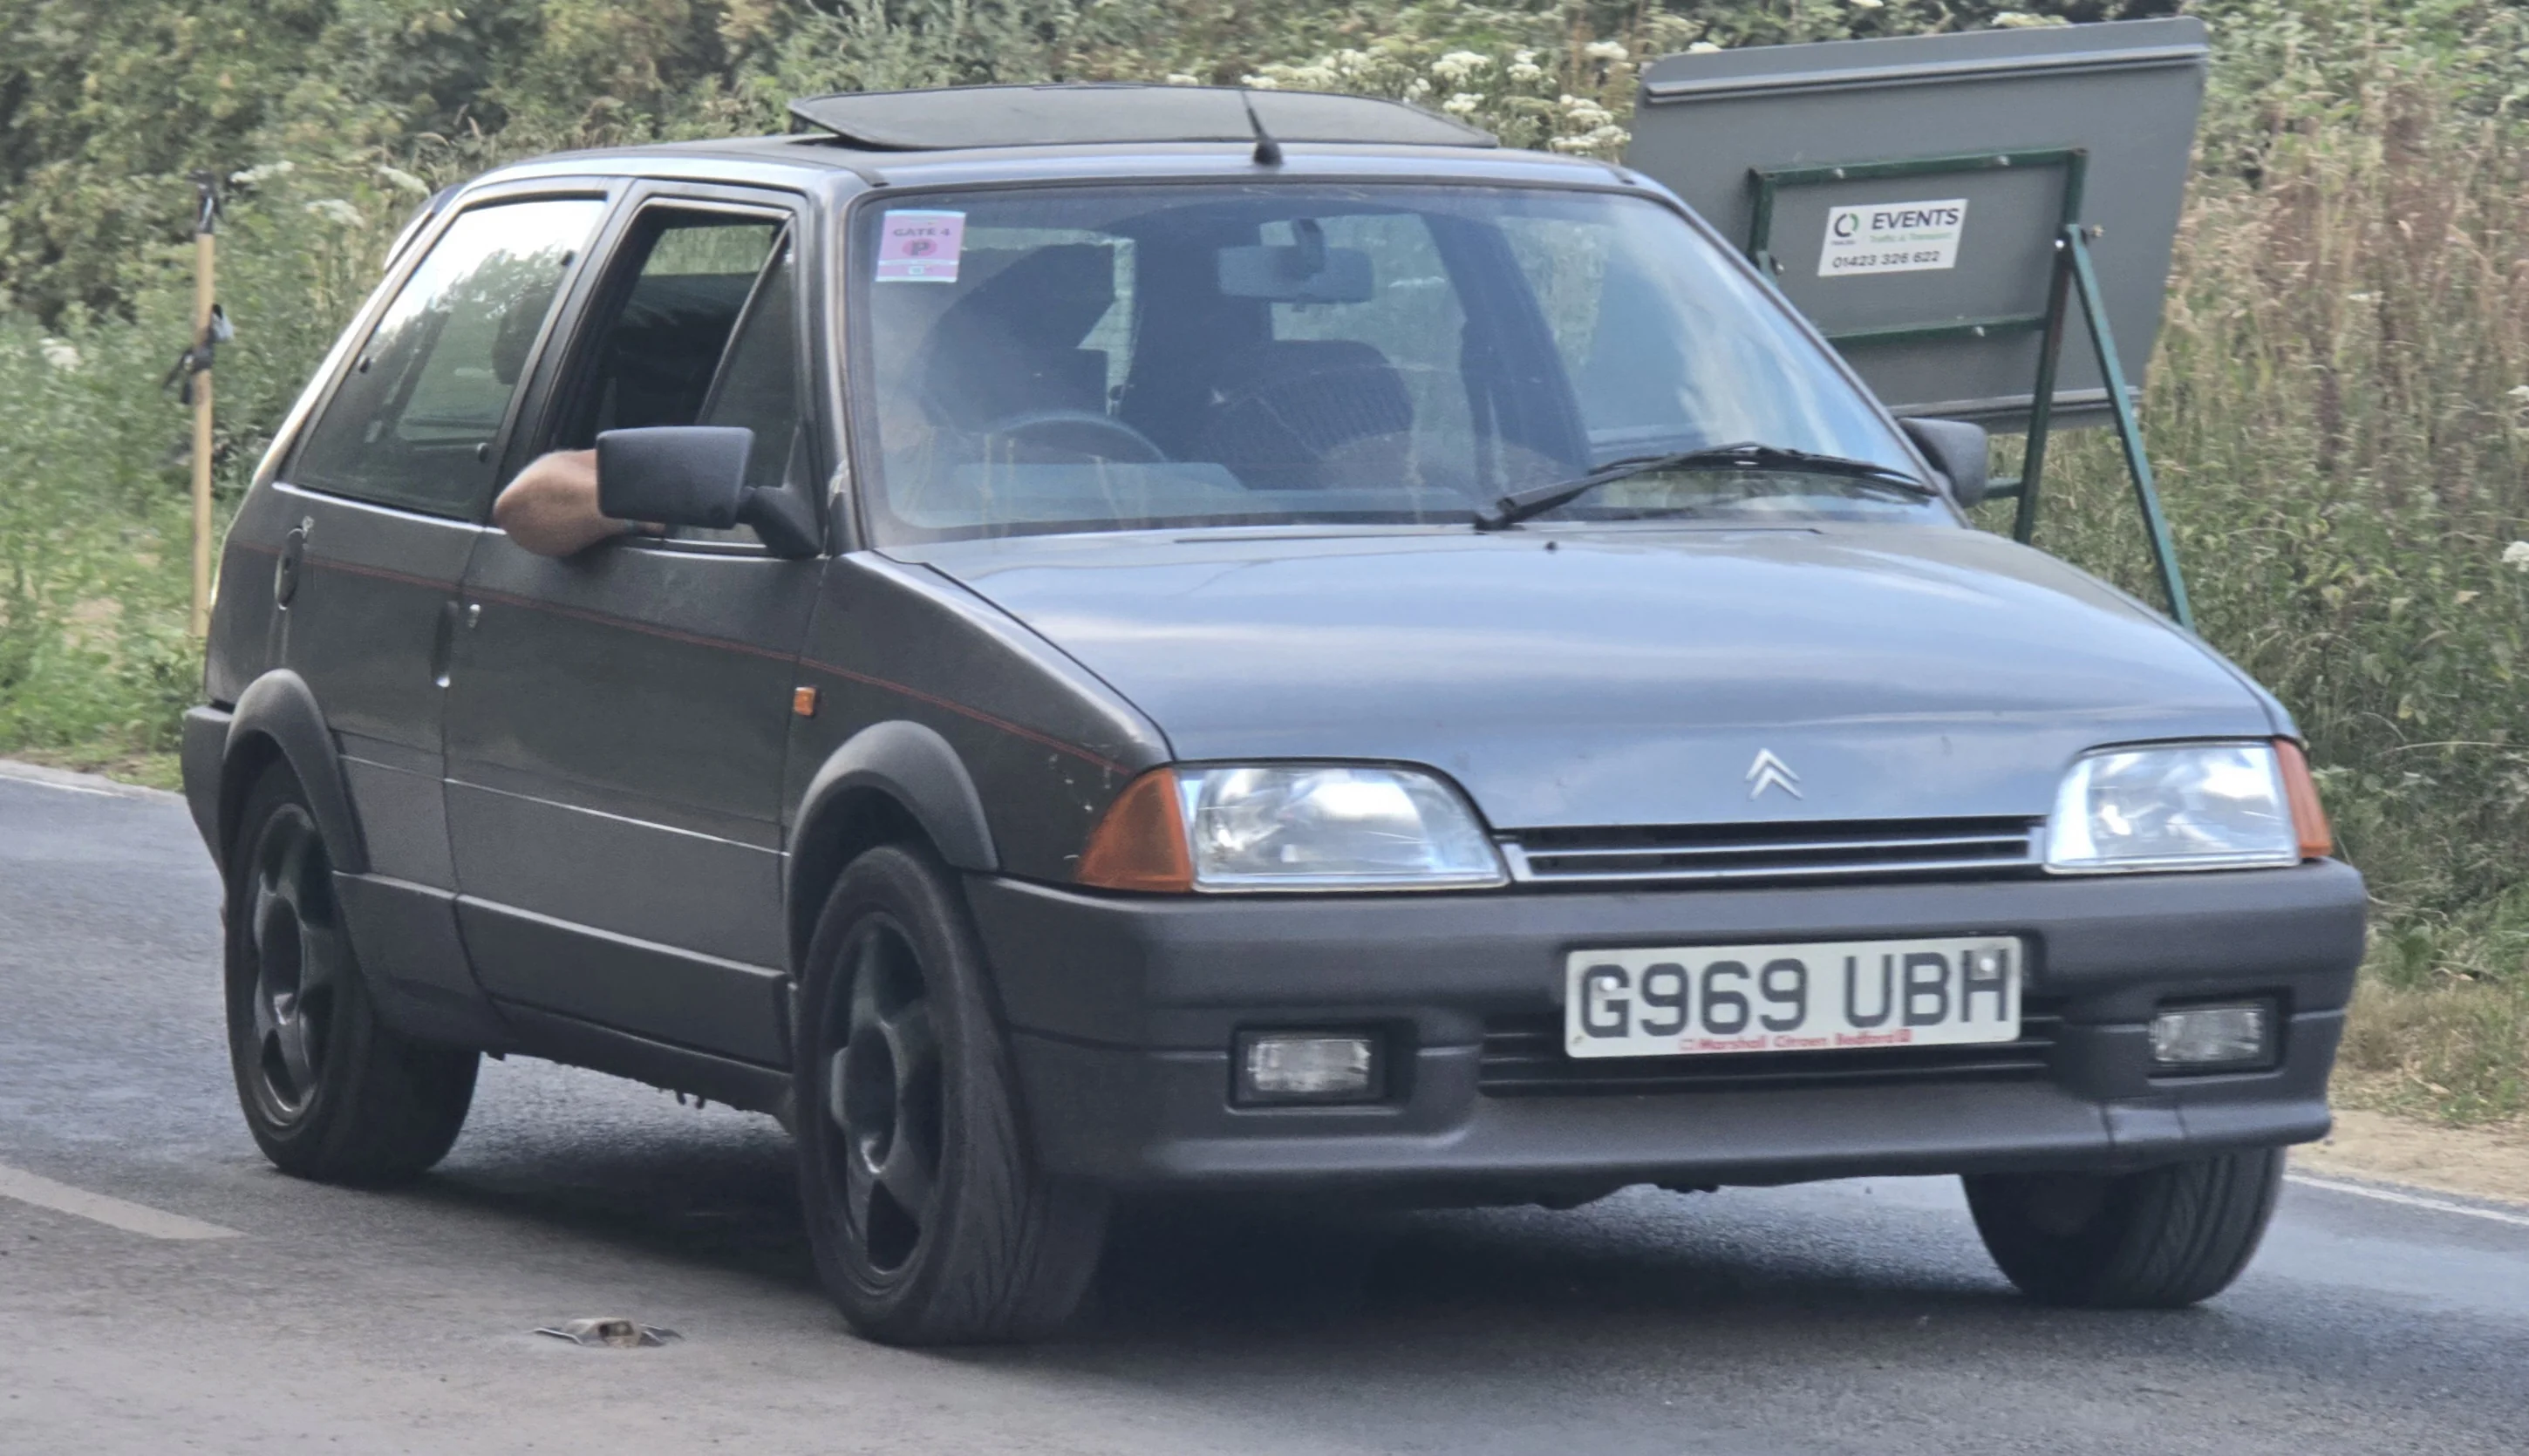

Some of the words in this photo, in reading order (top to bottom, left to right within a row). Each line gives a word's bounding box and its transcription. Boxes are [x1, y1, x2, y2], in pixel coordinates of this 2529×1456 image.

[1871, 208, 1960, 230] EVENTS
[911, 241, 930, 255] P
[1832, 255, 1878, 269] 01423
[1881, 253, 1909, 266] 326
[1912, 251, 1940, 263] 622
[1580, 958, 1808, 1038] G969
[1842, 949, 2008, 1029] UBH
[1699, 1036, 1767, 1050] Marshall
